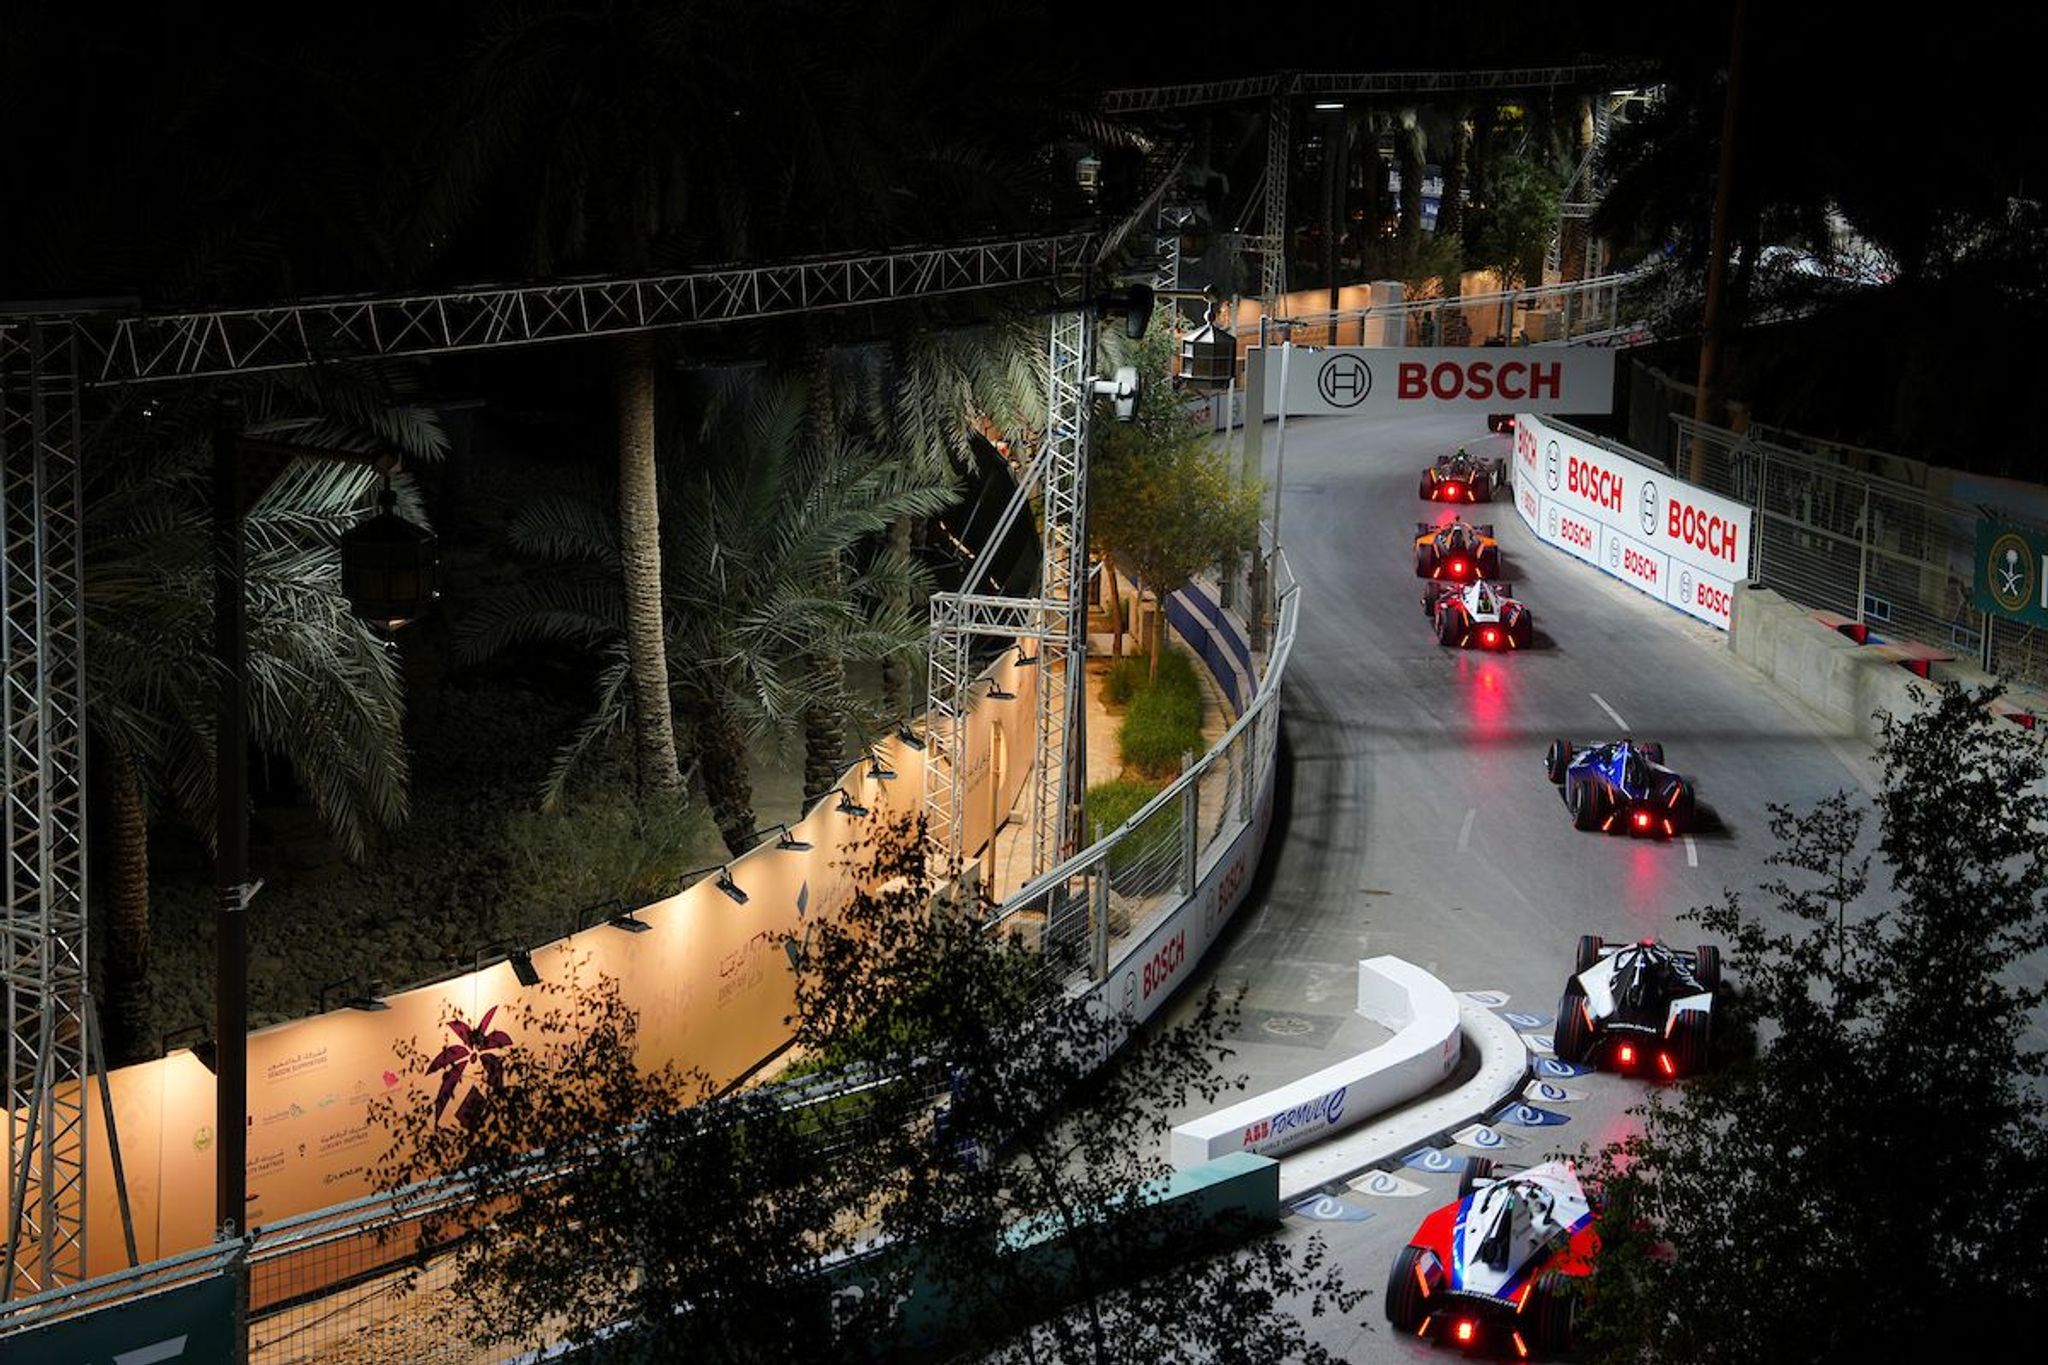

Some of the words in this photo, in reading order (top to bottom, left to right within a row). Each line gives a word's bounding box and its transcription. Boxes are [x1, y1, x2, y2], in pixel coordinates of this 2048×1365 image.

[1397, 361, 1561, 400] BOSCH
[1568, 456, 1624, 513] BOSCH
[1561, 518, 1593, 551] BOSCH
[1668, 498, 1738, 563] BOSCH
[1623, 548, 1658, 584] BOSCH
[1697, 583, 1733, 616] BOSC
[1143, 928, 1185, 1001] BOSCH
[1243, 1120, 1269, 1146] ABB
